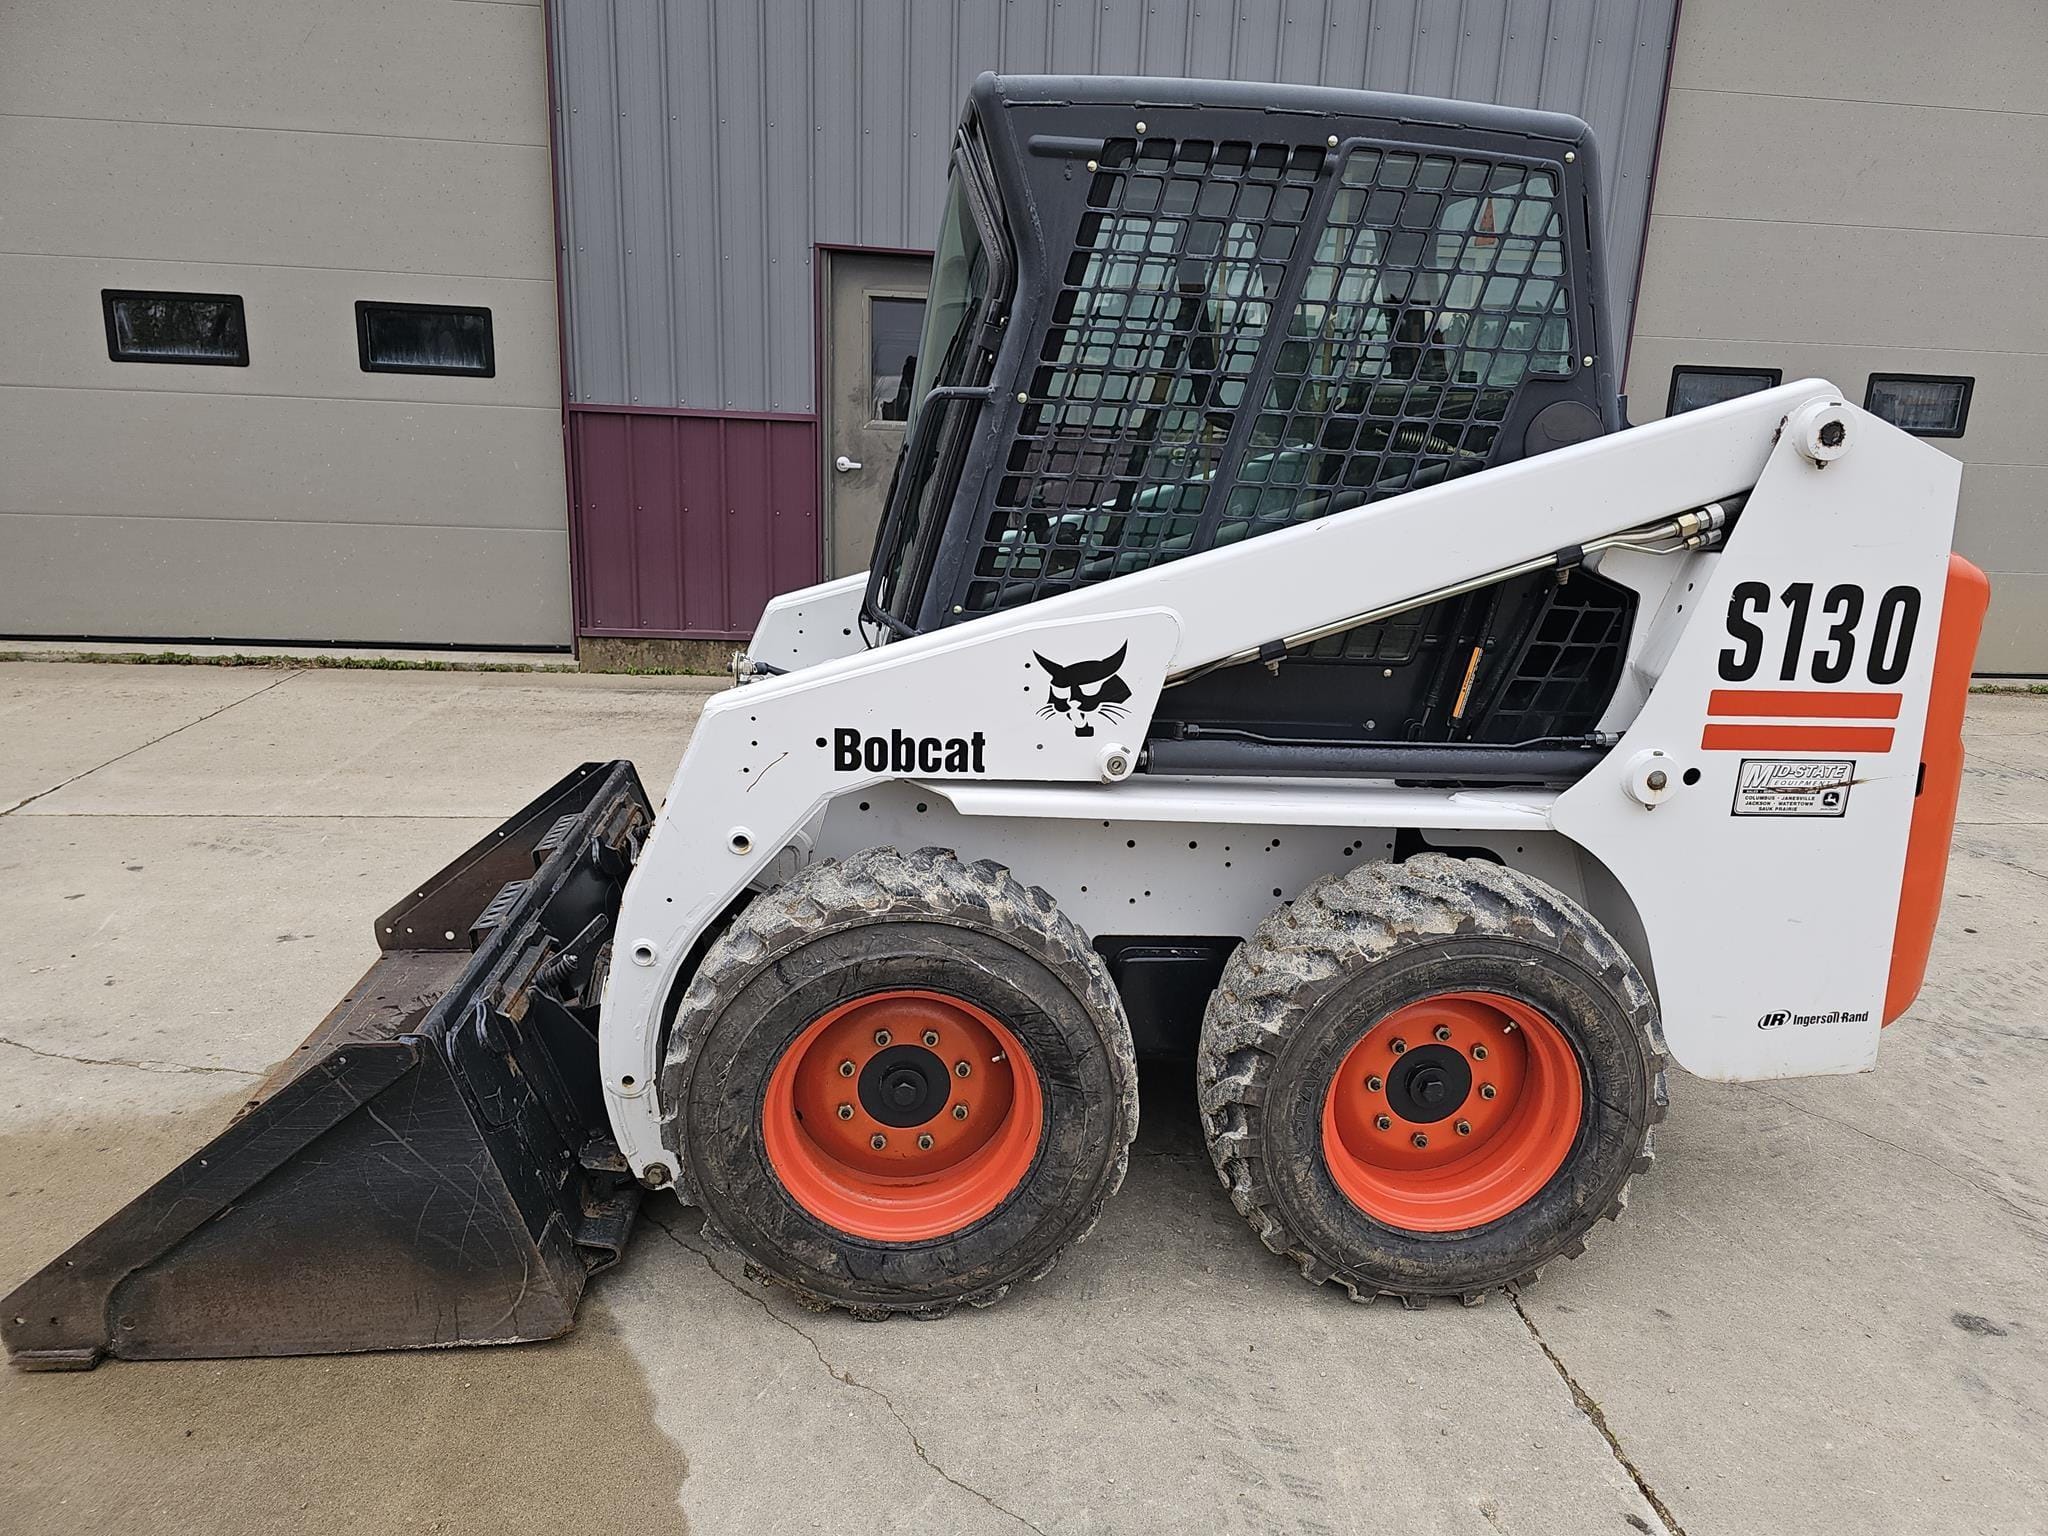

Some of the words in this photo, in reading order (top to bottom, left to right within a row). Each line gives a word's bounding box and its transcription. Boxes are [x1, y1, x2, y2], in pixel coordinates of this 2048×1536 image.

[1718, 581, 1921, 685] S130
[834, 728, 985, 773] Bobcat
[1742, 763, 1847, 788] MID-STATE
